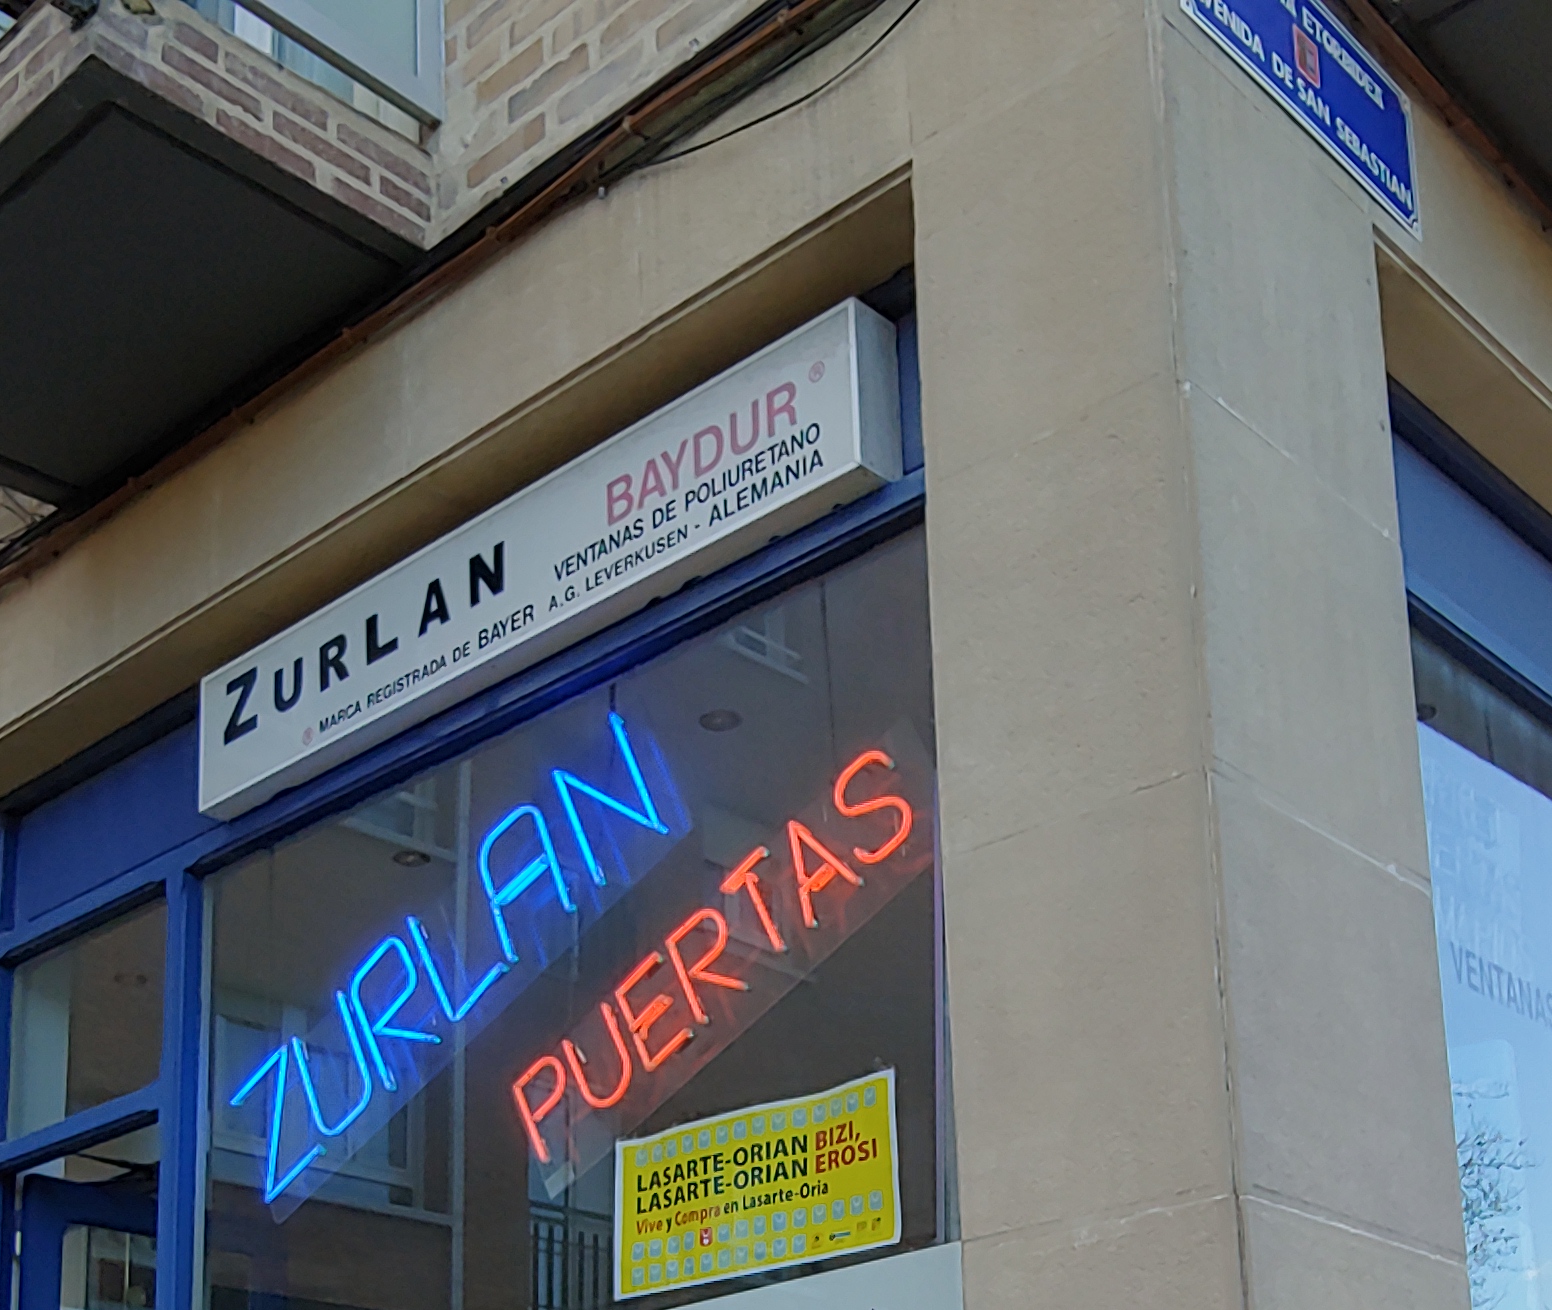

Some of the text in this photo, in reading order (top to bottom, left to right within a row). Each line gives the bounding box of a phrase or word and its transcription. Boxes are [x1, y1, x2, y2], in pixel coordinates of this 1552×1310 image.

[1200, 0, 1414, 211] ENIDA DE SAN SEBASTIAN
[553, 422, 821, 582] VENTANAS DE POLIURETANO
[605, 380, 798, 527] BAYDUR
[222, 538, 507, 746] ZURLAN
[318, 705, 363, 734] MARCA
[367, 654, 447, 709] REGISTRADA
[451, 640, 471, 664] DE
[477, 604, 536, 651] BAYER
[548, 585, 580, 612] A.G.
[585, 523, 689, 593] LEVERKUSEN
[708, 448, 824, 528] ALEMANIA
[230, 711, 670, 1204] ZURLAN
[512, 750, 914, 1164] PUERTAS
[636, 1120, 861, 1193] LASARTE-ORIAN BIZI,
[636, 1138, 879, 1215] LASARTE-ORIAN EROSI
[636, 1180, 829, 1236] Vive y Compra en Lasarte-Oria
